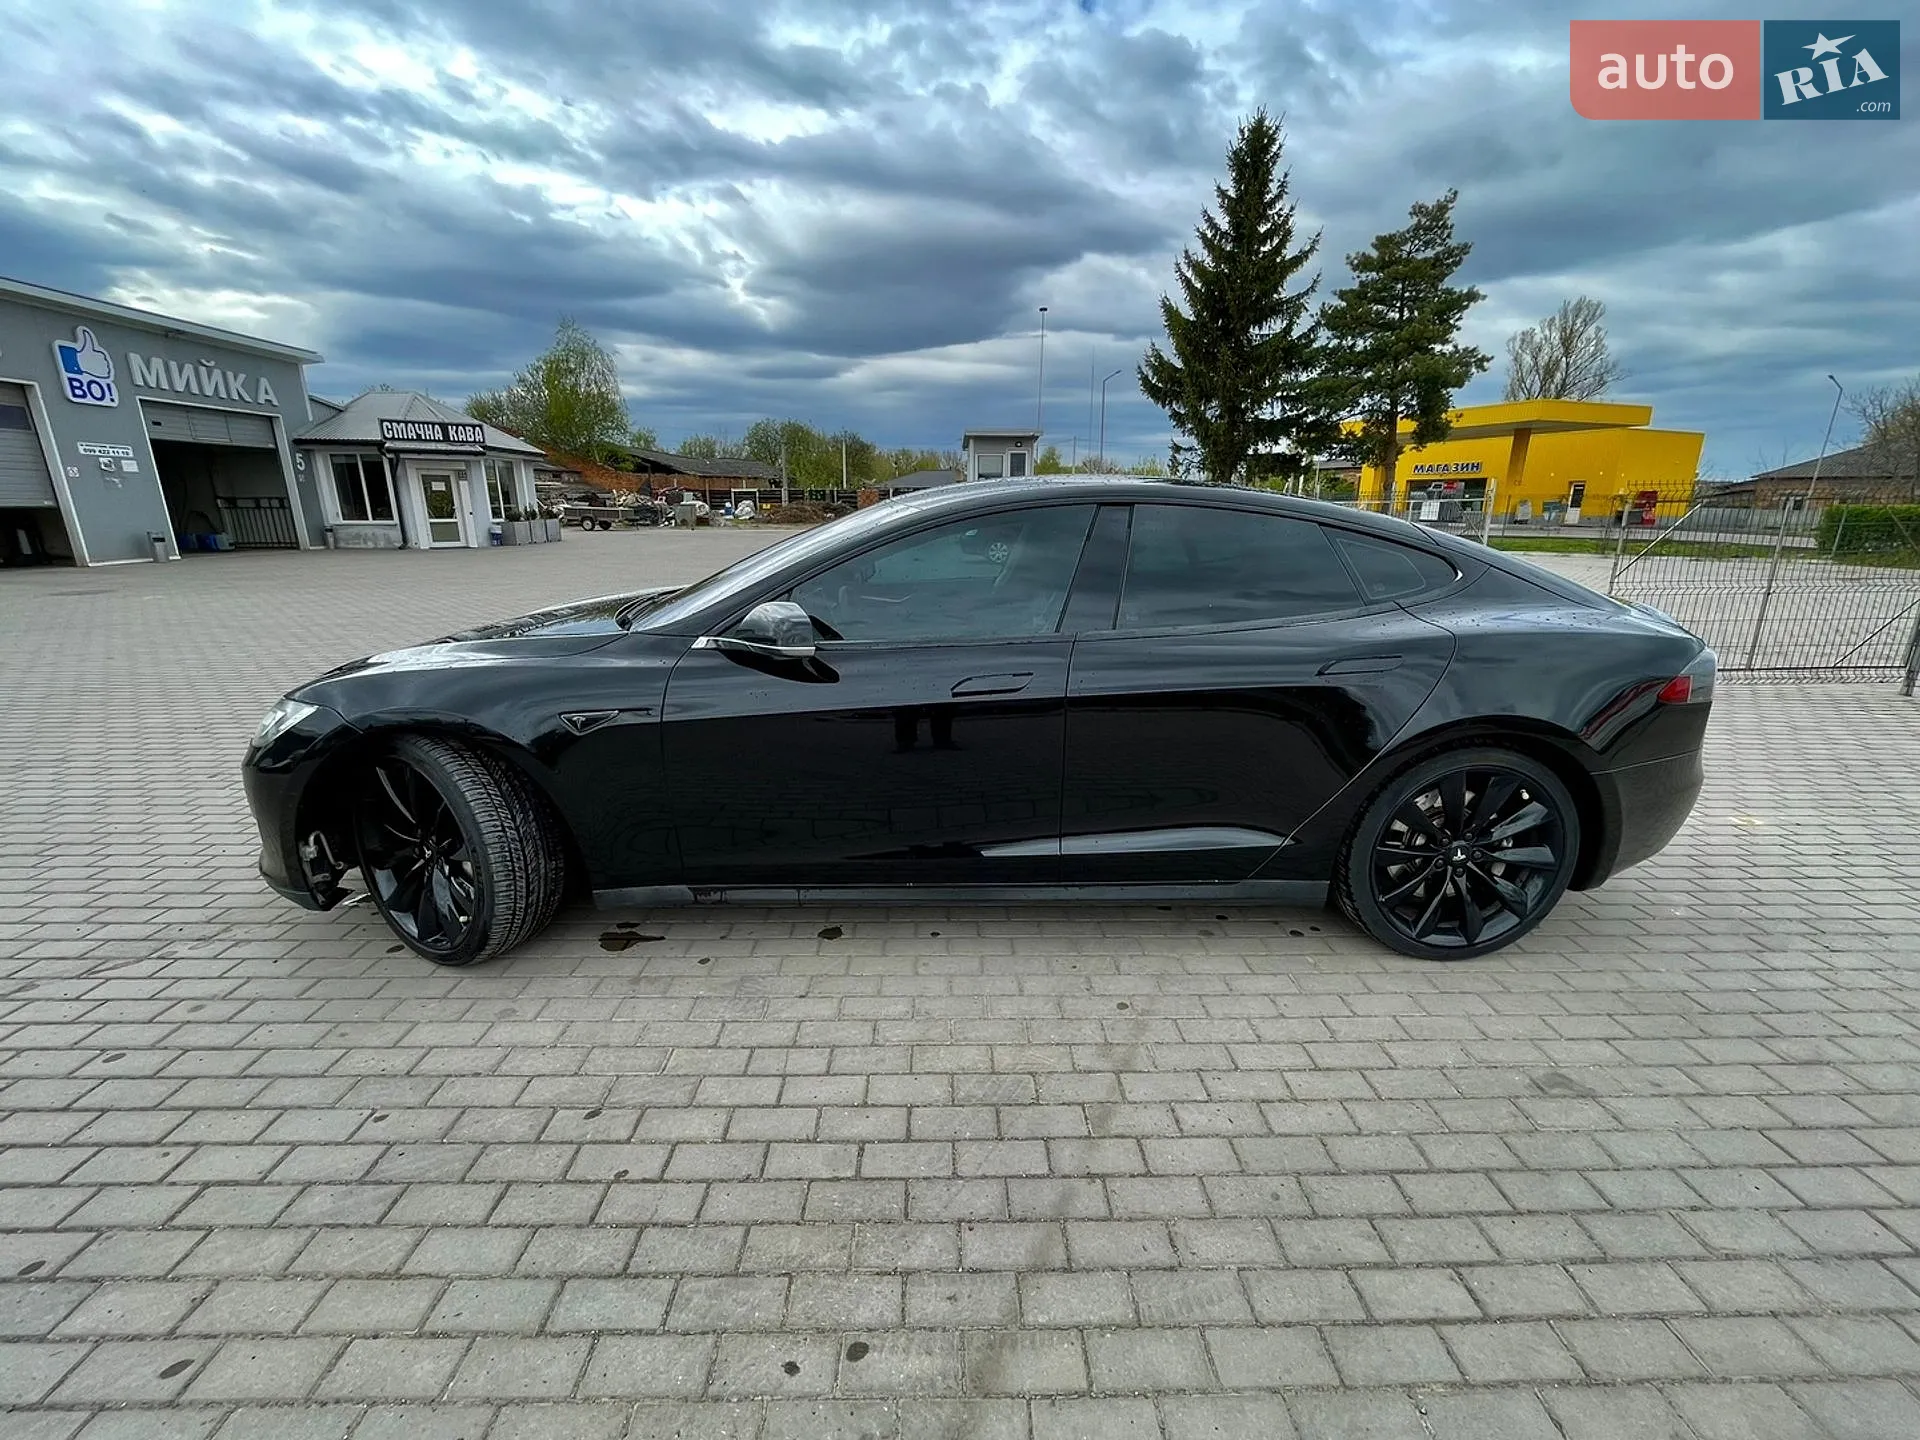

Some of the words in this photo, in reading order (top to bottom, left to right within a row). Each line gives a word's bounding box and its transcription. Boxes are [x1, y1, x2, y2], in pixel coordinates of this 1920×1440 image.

[67, 376, 116, 404] ВО!
[127, 351, 280, 407] МИЙКА
[382, 421, 443, 441] СМАЧНА
[449, 424, 484, 443] КАВА
[296, 452, 305, 471] 5
[1413, 461, 1481, 474] МАГАЗИН
